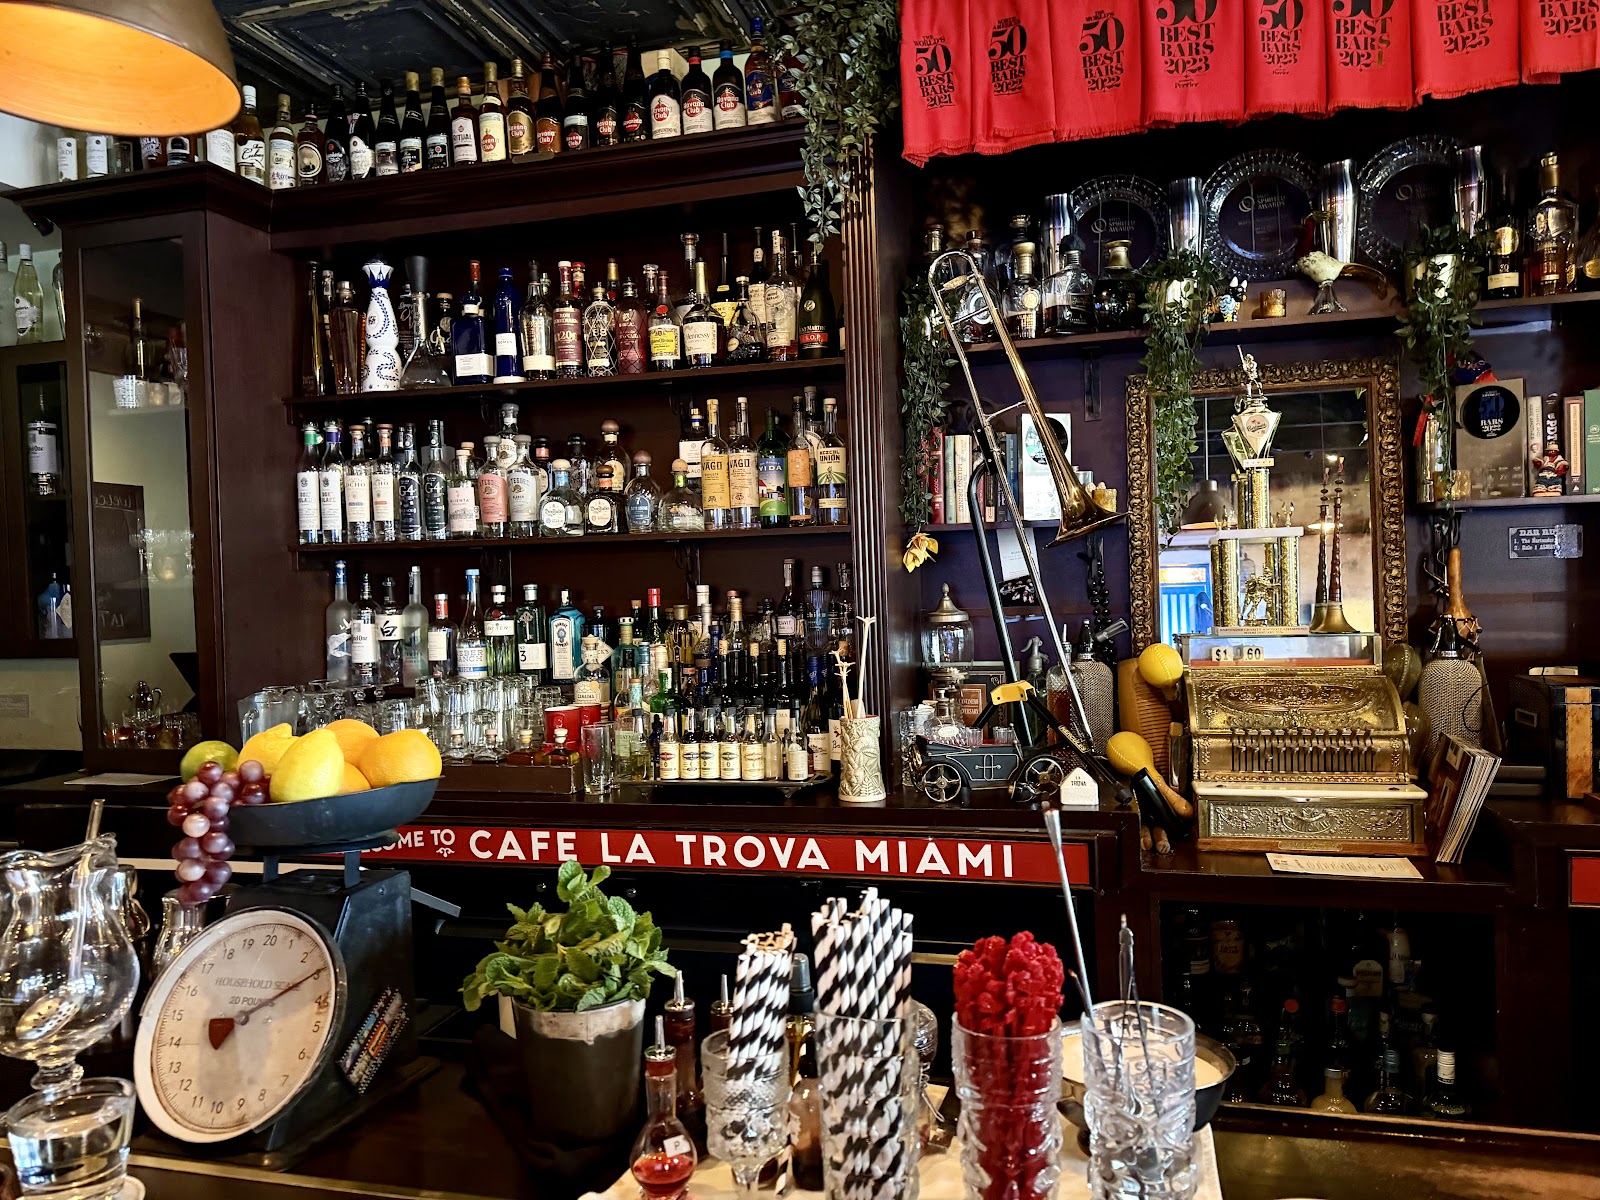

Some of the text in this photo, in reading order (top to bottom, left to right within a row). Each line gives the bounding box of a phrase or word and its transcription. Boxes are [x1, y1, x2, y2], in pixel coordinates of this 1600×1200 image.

[1258, 0, 1304, 30] 50
[1437, 0, 1490, 22] BEST
[1540, 0, 1600, 18] BARS
[1335, 17, 1393, 35] BEST
[1439, 12, 1494, 37] BARS
[1544, 14, 1597, 36] 2026
[1079, 17, 1125, 55] 50
[1160, 22, 1215, 42] BEST
[1261, 29, 1302, 42] BEST
[988, 24, 1027, 60] 50
[1262, 41, 1301, 53] BARS
[1336, 32, 1391, 50] BARS
[1443, 29, 1491, 54] 2025
[1161, 40, 1214, 57] BARS
[915, 44, 952, 75] 50
[990, 54, 1027, 72] BEST
[1082, 50, 1125, 68] BEST
[1164, 56, 1210, 75] 2023
[1264, 53, 1298, 65] 2023
[991, 67, 1026, 83] BARS
[1083, 64, 1124, 79] BARS
[917, 72, 954, 87] BEST
[993, 79, 1023, 93] 2022
[1087, 76, 1121, 91] 2022
[920, 83, 955, 97] BARS
[926, 93, 953, 107] 2021
[686, 106, 701, 114] Club
[539, 136, 552, 144] Club
[1480, 418, 1504, 427] BARS
[1546, 419, 1558, 442] PDT
[701, 461, 723, 471] VAGO
[730, 458, 751, 469] VAGO
[399, 484, 417, 497] G4
[425, 482, 443, 494] G4
[380, 620, 398, 637] 白
[520, 651, 527, 662] 3
[1215, 648, 1229, 661] $1
[430, 828, 456, 846] TO
[469, 830, 577, 861] CAFE
[600, 833, 656, 864] LA
[675, 834, 829, 870] TROVA
[855, 840, 1013, 878] MIAMI
[241, 938, 255, 950] 19
[263, 935, 277, 946] 20
[288, 939, 293, 949] 1
[222, 949, 235, 960] 18
[301, 952, 308, 963] 2
[202, 963, 214, 975] 17
[215, 977, 272, 990] HOUSEHOLD
[185, 985, 198, 997] 16
[229, 996, 240, 1004] 20
[171, 1009, 183, 1021] 15
[312, 1021, 321, 1033] 5
[169, 1037, 181, 1048] 14
[298, 1048, 305, 1060] 6
[168, 1062, 181, 1073] 13
[179, 1079, 192, 1091] 12
[282, 1075, 289, 1087] 7
[258, 1089, 266, 1101] 8
[192, 1096, 204, 1108] 11
[210, 1102, 223, 1114] 10
[237, 1098, 245, 1110] 9
